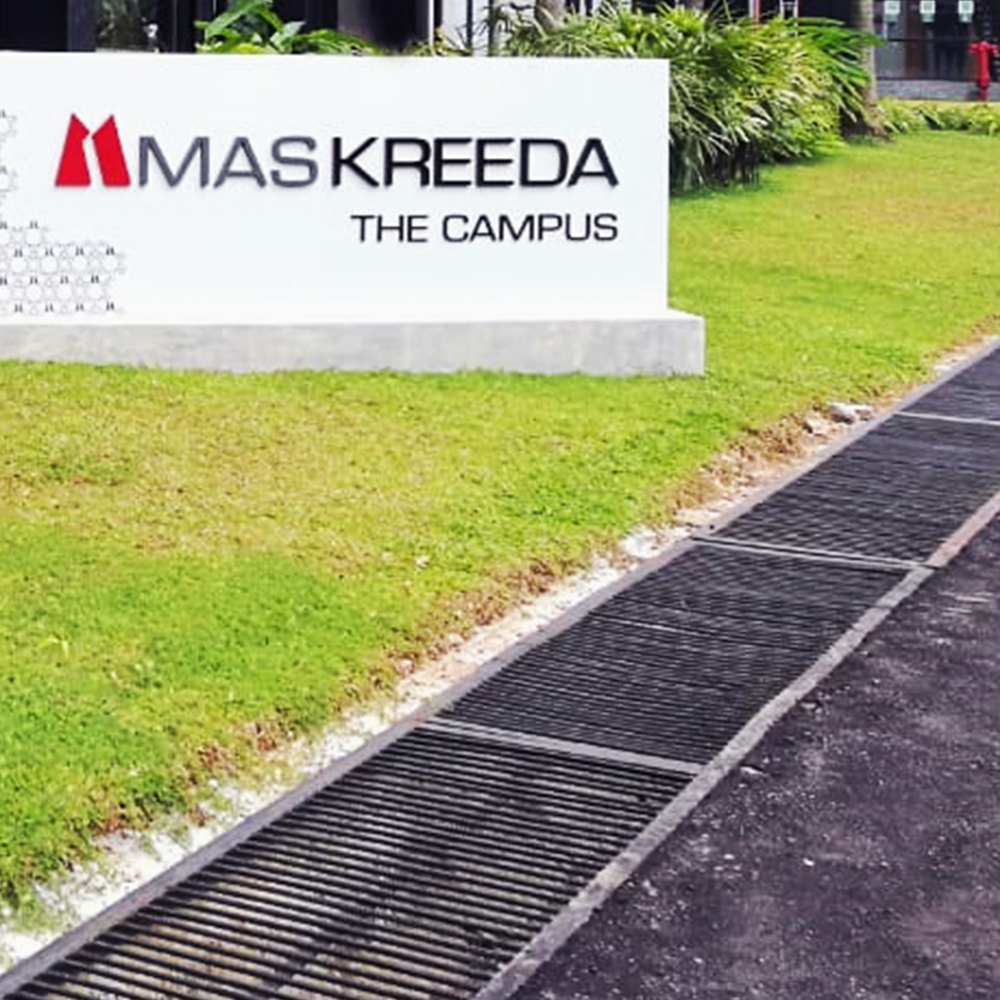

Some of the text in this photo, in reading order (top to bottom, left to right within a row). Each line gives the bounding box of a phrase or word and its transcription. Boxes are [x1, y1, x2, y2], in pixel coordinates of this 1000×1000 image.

[139, 136, 619, 189] MAS KREEDA
[350, 213, 618, 243] THE CAMPUS
